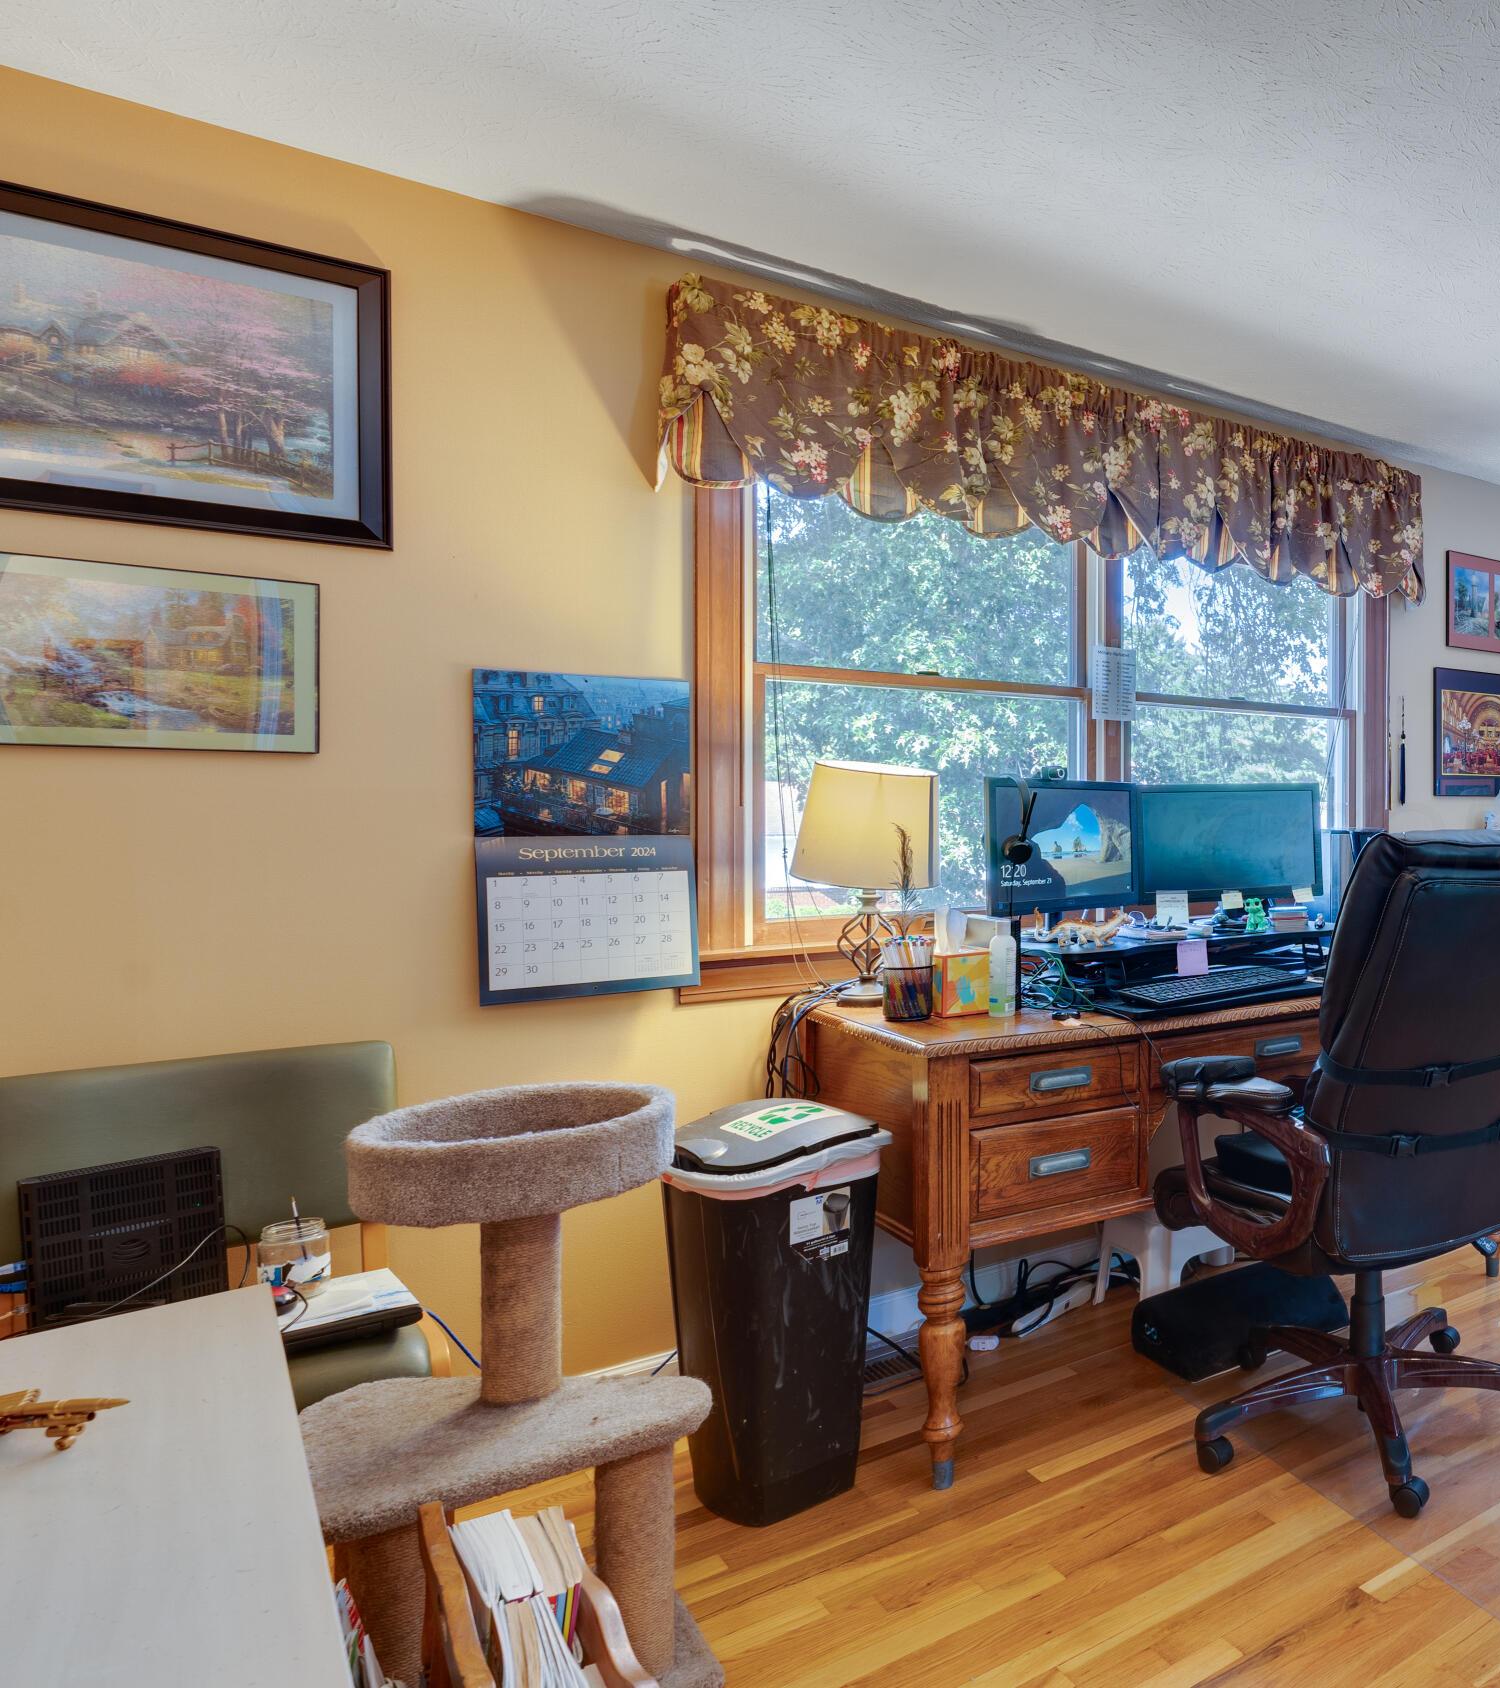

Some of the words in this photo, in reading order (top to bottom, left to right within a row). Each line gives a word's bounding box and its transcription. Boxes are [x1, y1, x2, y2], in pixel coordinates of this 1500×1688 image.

[518, 846, 625, 862] September
[631, 847, 656, 857] 2024
[1000, 864, 1026, 878] 12:20
[522, 878, 528, 886] 2
[552, 877, 558, 885] 3
[579, 876, 586, 884] 4
[607, 875, 613, 883] 5
[633, 874, 639, 882] 6
[658, 873, 664, 881] 7
[495, 901, 501, 909] 8
[524, 900, 530, 908] 9
[552, 898, 563, 907] 10
[580, 897, 589, 905] 11
[608, 896, 617, 904] 12
[634, 895, 643, 903] 13
[495, 923, 505, 932] 15
[524, 922, 534, 930] 16
[553, 920, 563, 928] 17
[581, 919, 591, 927] 18
[608, 917, 618, 925] 19
[634, 915, 646, 924] 20
[661, 914, 670, 922] 21
[495, 945, 506, 954] 22
[524, 944, 536, 952] 23
[553, 942, 564, 950] 24
[582, 940, 592, 948] 25
[609, 938, 620, 946] 26
[635, 936, 646, 944] 27
[661, 935, 672, 943] 28
[495, 968, 507, 977] 29
[526, 965, 538, 974] 30
[728, 1120, 773, 1138] RECYCLE
